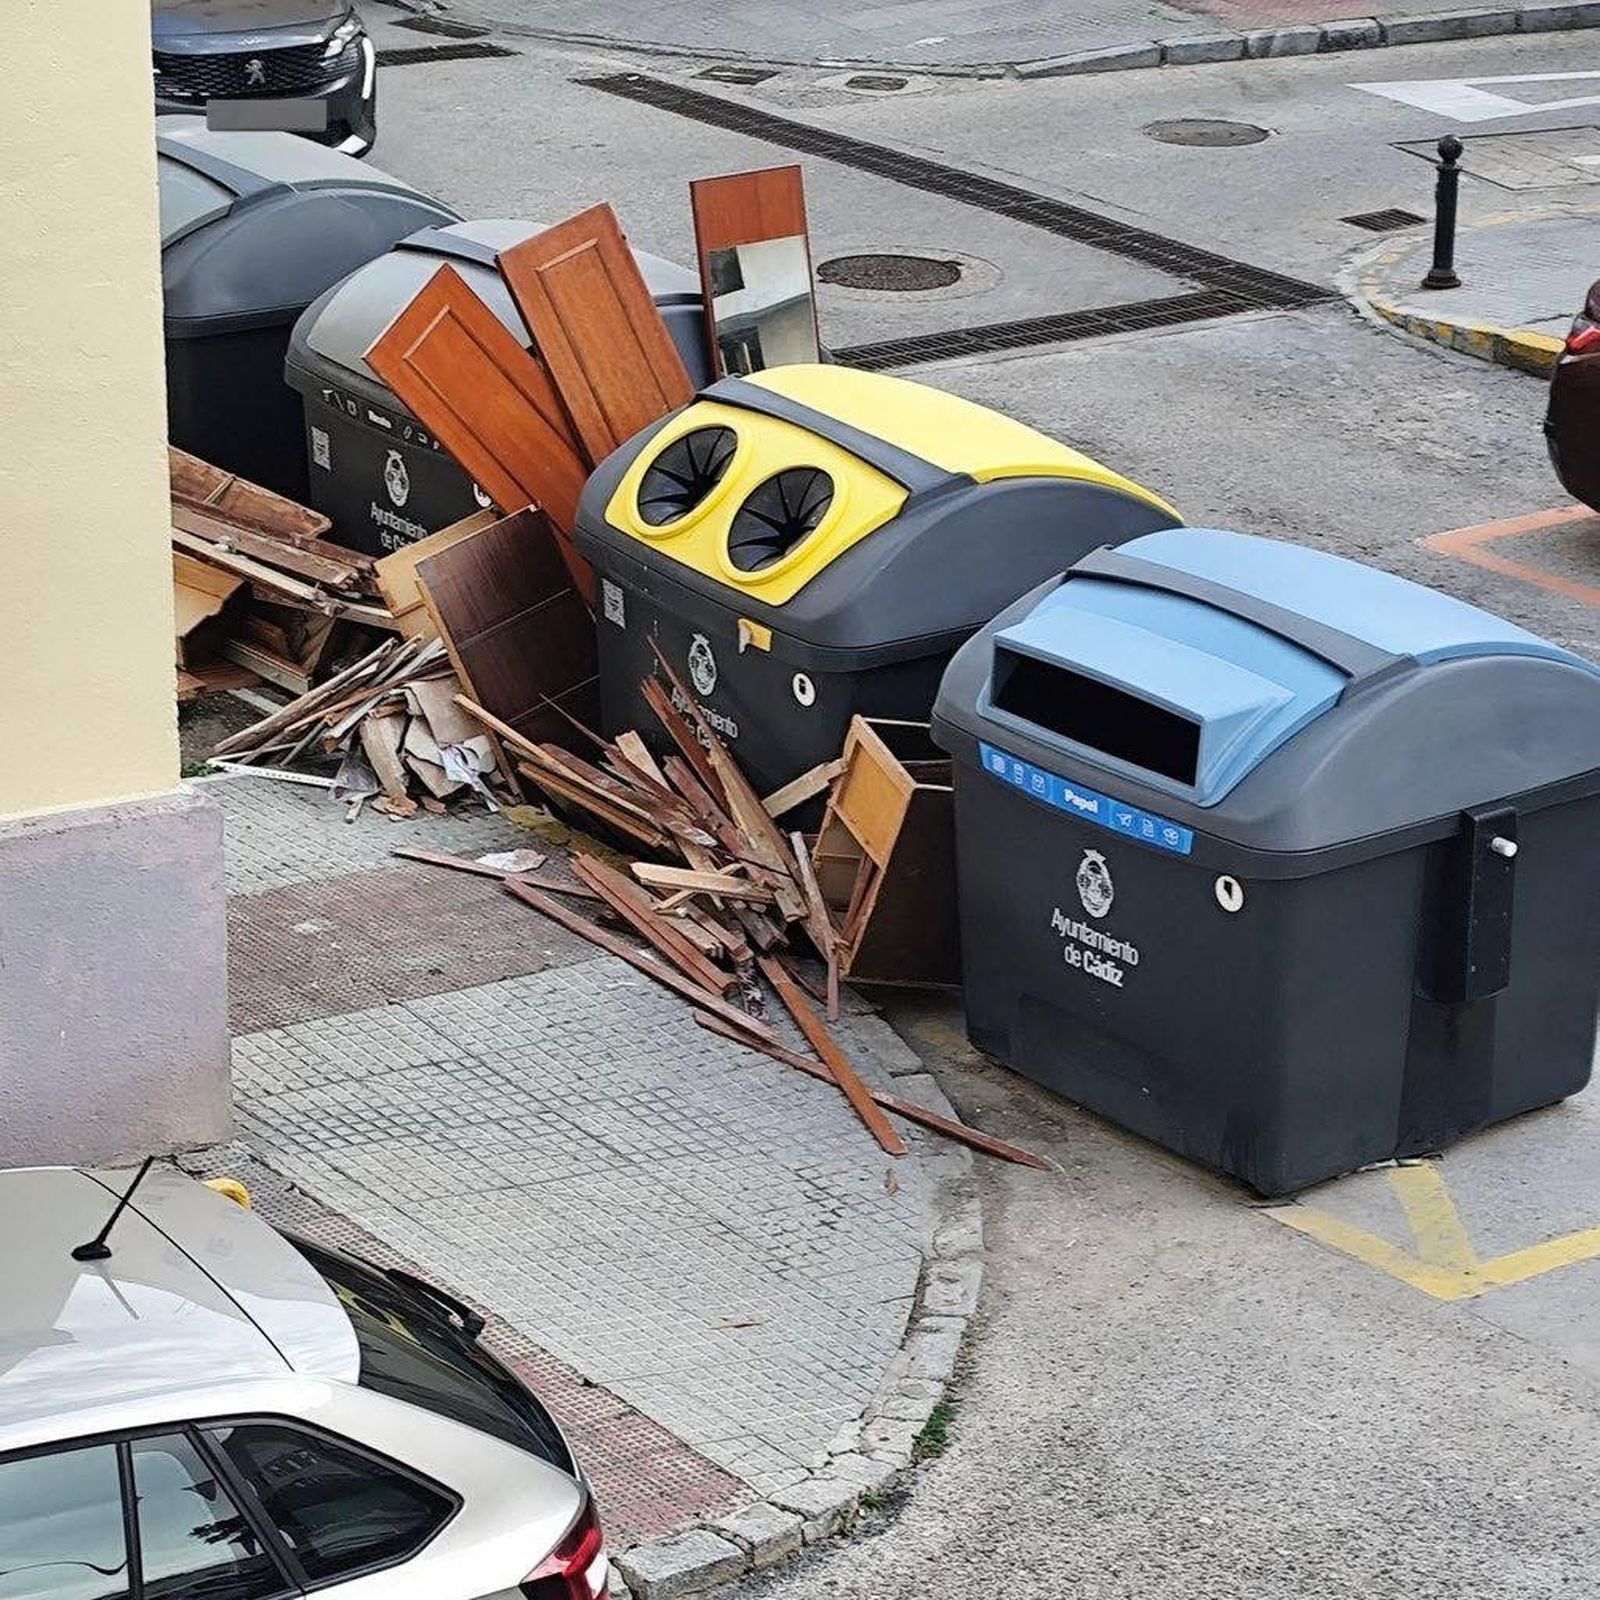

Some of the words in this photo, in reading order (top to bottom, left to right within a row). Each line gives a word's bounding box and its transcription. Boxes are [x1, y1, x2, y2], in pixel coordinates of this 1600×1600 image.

[1064, 788, 1098, 813] Papel
[1051, 907, 1139, 966] Ayuntamiento
[1064, 943, 1081, 969] de
[1083, 950, 1123, 988] Cádiz
